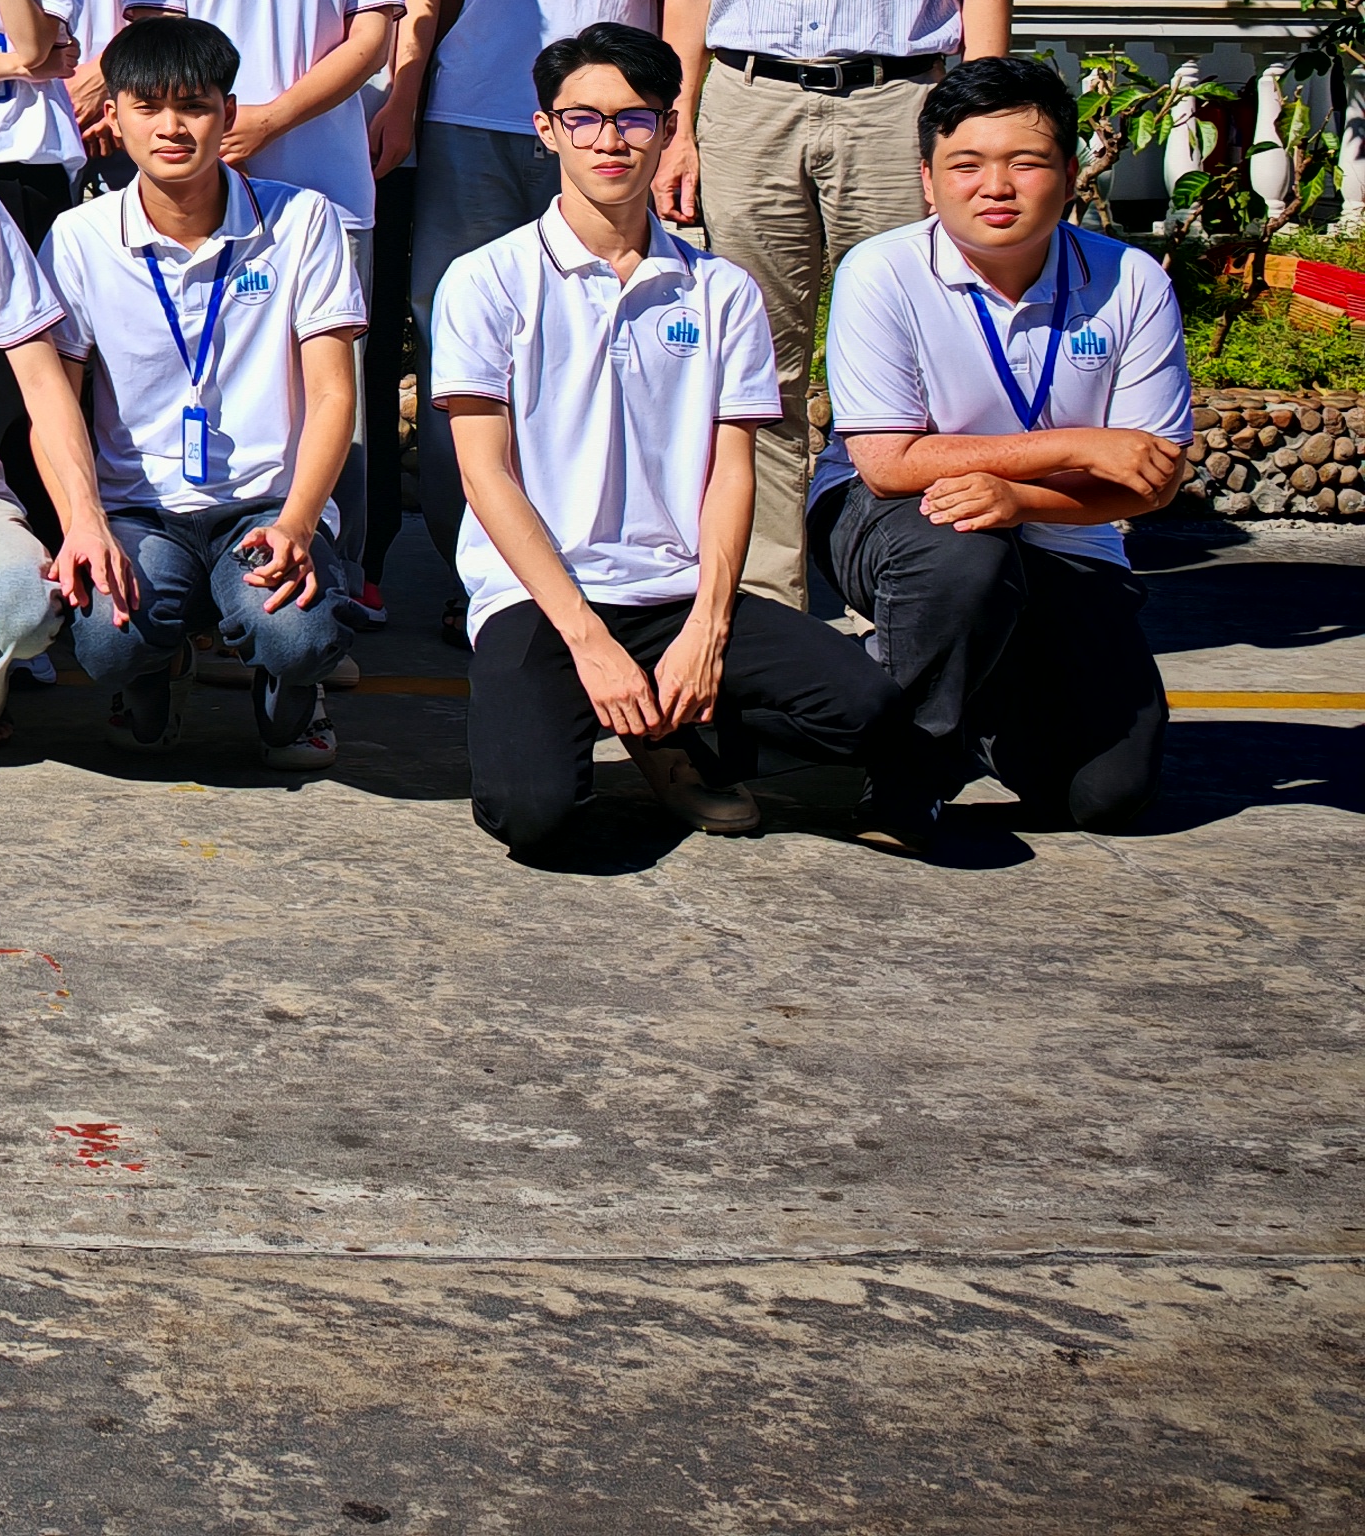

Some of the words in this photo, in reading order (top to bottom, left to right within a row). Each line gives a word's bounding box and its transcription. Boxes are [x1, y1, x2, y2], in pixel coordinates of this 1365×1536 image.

[236, 273, 268, 293] NTU
[667, 324, 699, 344] NTU
[1072, 334, 1107, 355] NTU
[187, 441, 200, 460] 25
